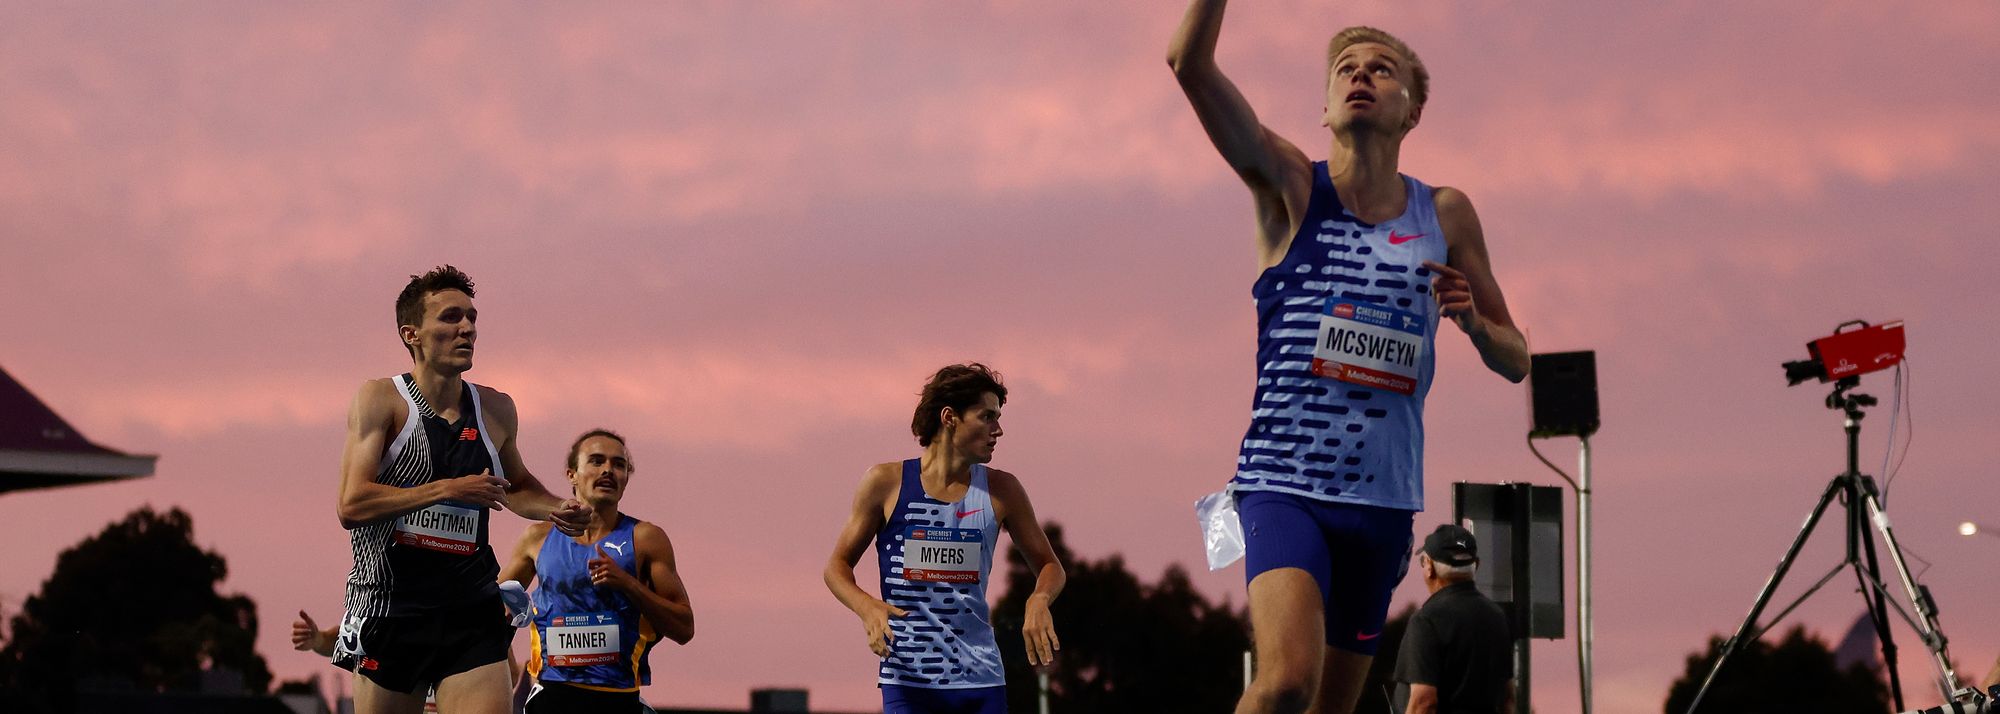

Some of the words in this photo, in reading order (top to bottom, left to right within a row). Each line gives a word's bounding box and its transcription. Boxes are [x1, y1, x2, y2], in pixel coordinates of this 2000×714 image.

[1356, 306, 1393, 321] CHEMIST
[1325, 327, 1416, 368] MCSWEYN
[1832, 363, 1858, 375] OMEGA
[403, 510, 474, 535] WIGHTMAN
[920, 546, 965, 565] MYERS
[558, 631, 607, 649] TANNER
